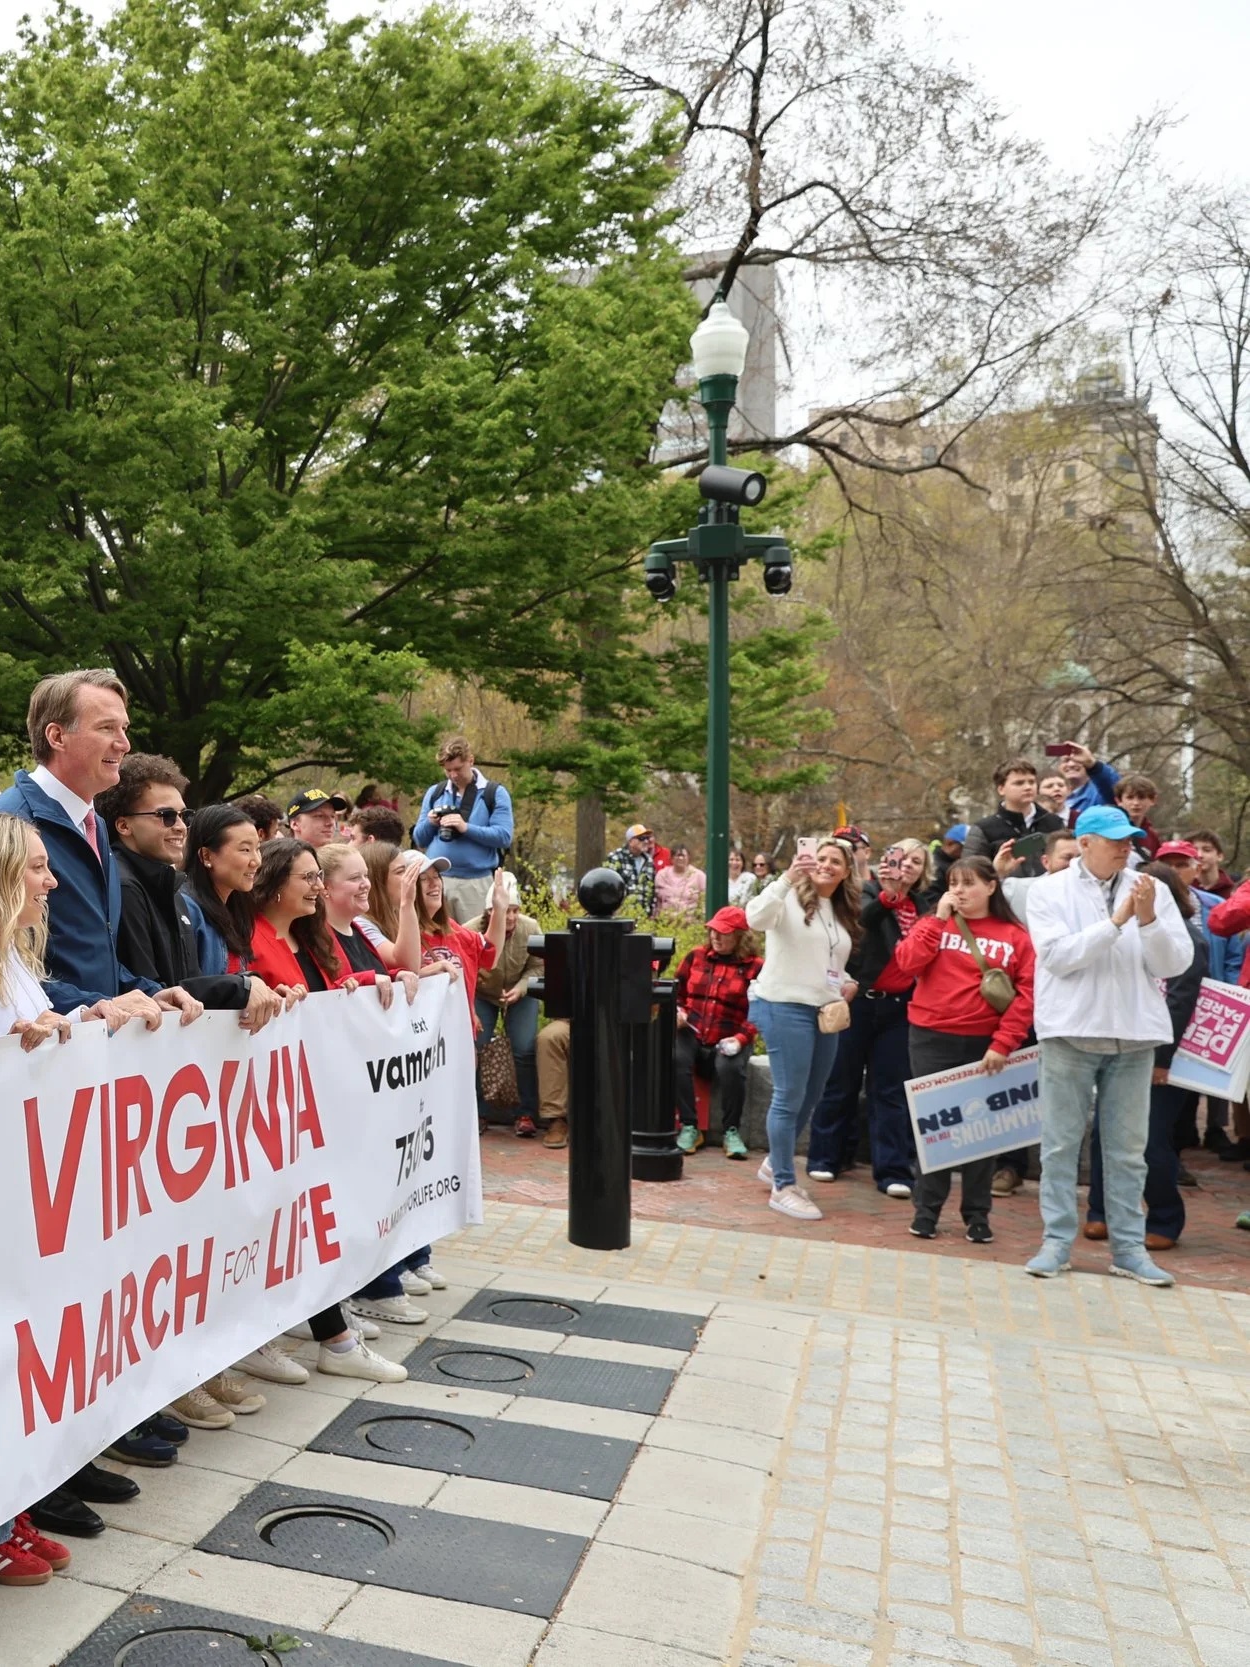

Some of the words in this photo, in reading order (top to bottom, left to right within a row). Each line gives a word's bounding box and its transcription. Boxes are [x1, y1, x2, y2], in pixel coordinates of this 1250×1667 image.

[940, 932, 1015, 968] IBRTY
[366, 1028, 446, 1093] vamah
[23, 1039, 326, 1258] VIRGINIA
[951, 1102, 1041, 1149] HAMPIONS
[14, 1236, 215, 1437] MARCH
[222, 1238, 261, 1293] FOR
[265, 1183, 341, 1289] LIFE
